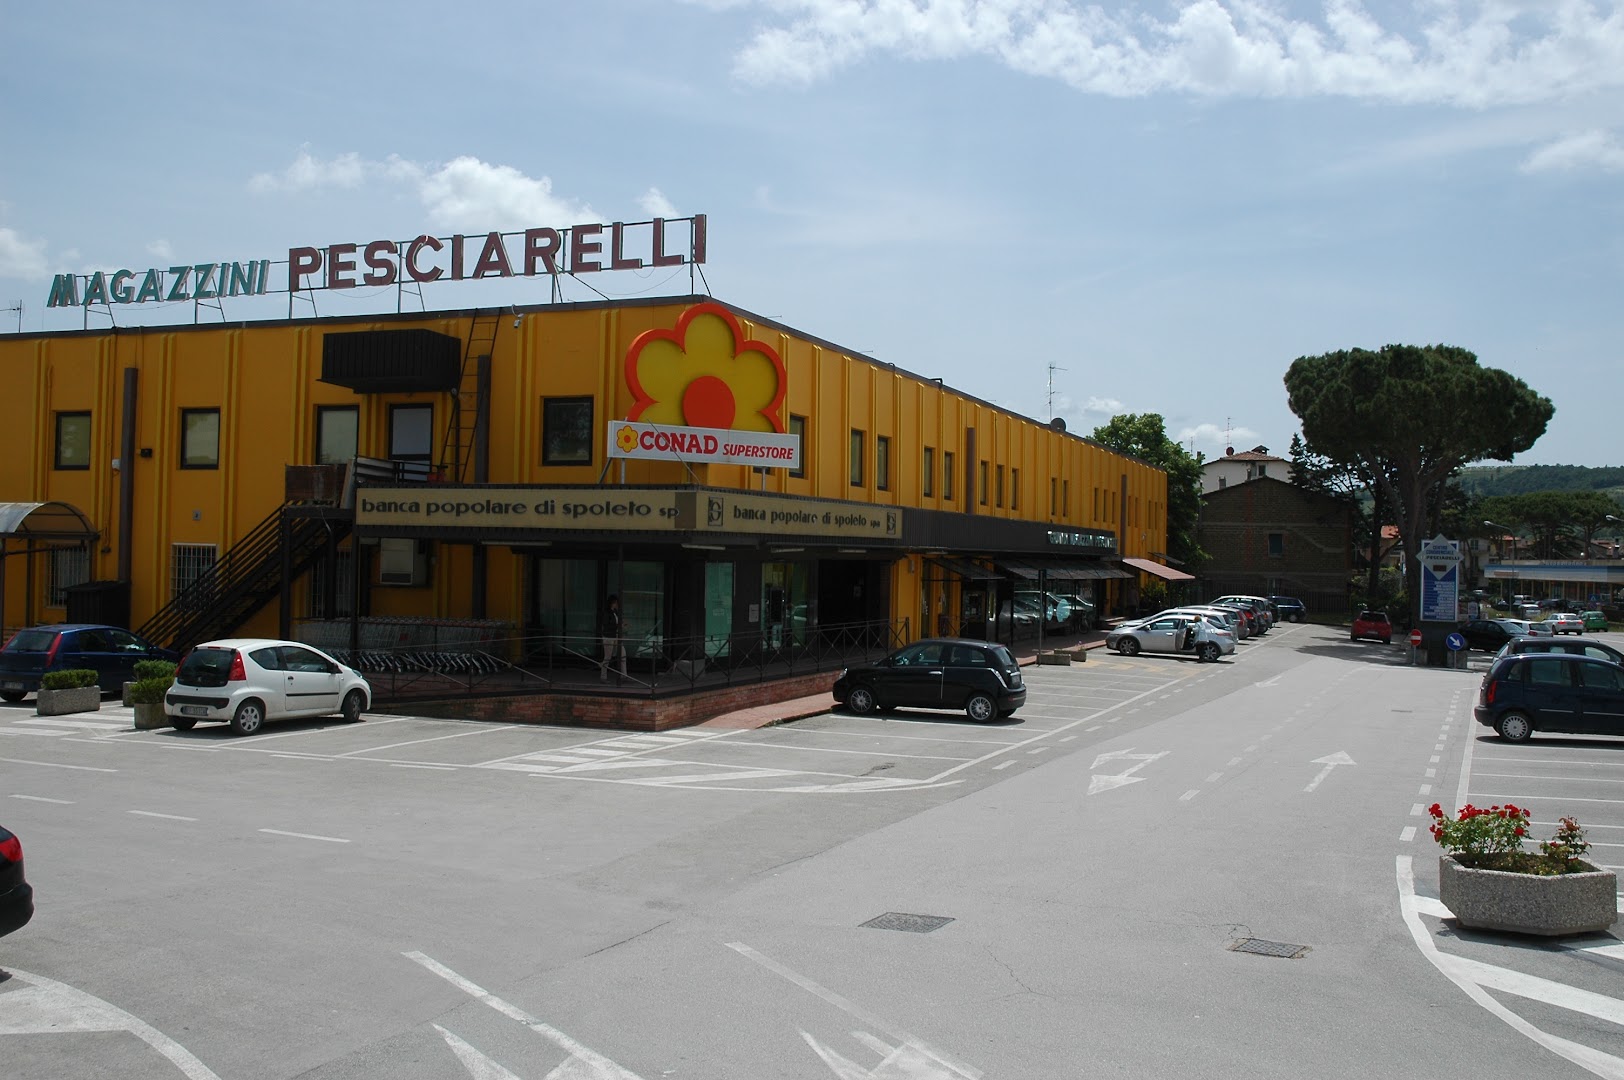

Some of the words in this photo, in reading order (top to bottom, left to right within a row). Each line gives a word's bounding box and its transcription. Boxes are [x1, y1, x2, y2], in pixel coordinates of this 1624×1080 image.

[47, 260, 270, 307] MAGAZZINI
[289, 214, 707, 291] PESCIARELLI
[640, 431, 718, 455] CONAD
[723, 443, 793, 460] SUPERSTORE
[361, 498, 420, 513] banca
[426, 499, 527, 517] popolare
[534, 499, 556, 515] di
[562, 500, 651, 519] spoleto
[733, 505, 766, 521] banca
[771, 509, 818, 525] popolare
[822, 511, 831, 524] di
[834, 513, 867, 528] spoleto
